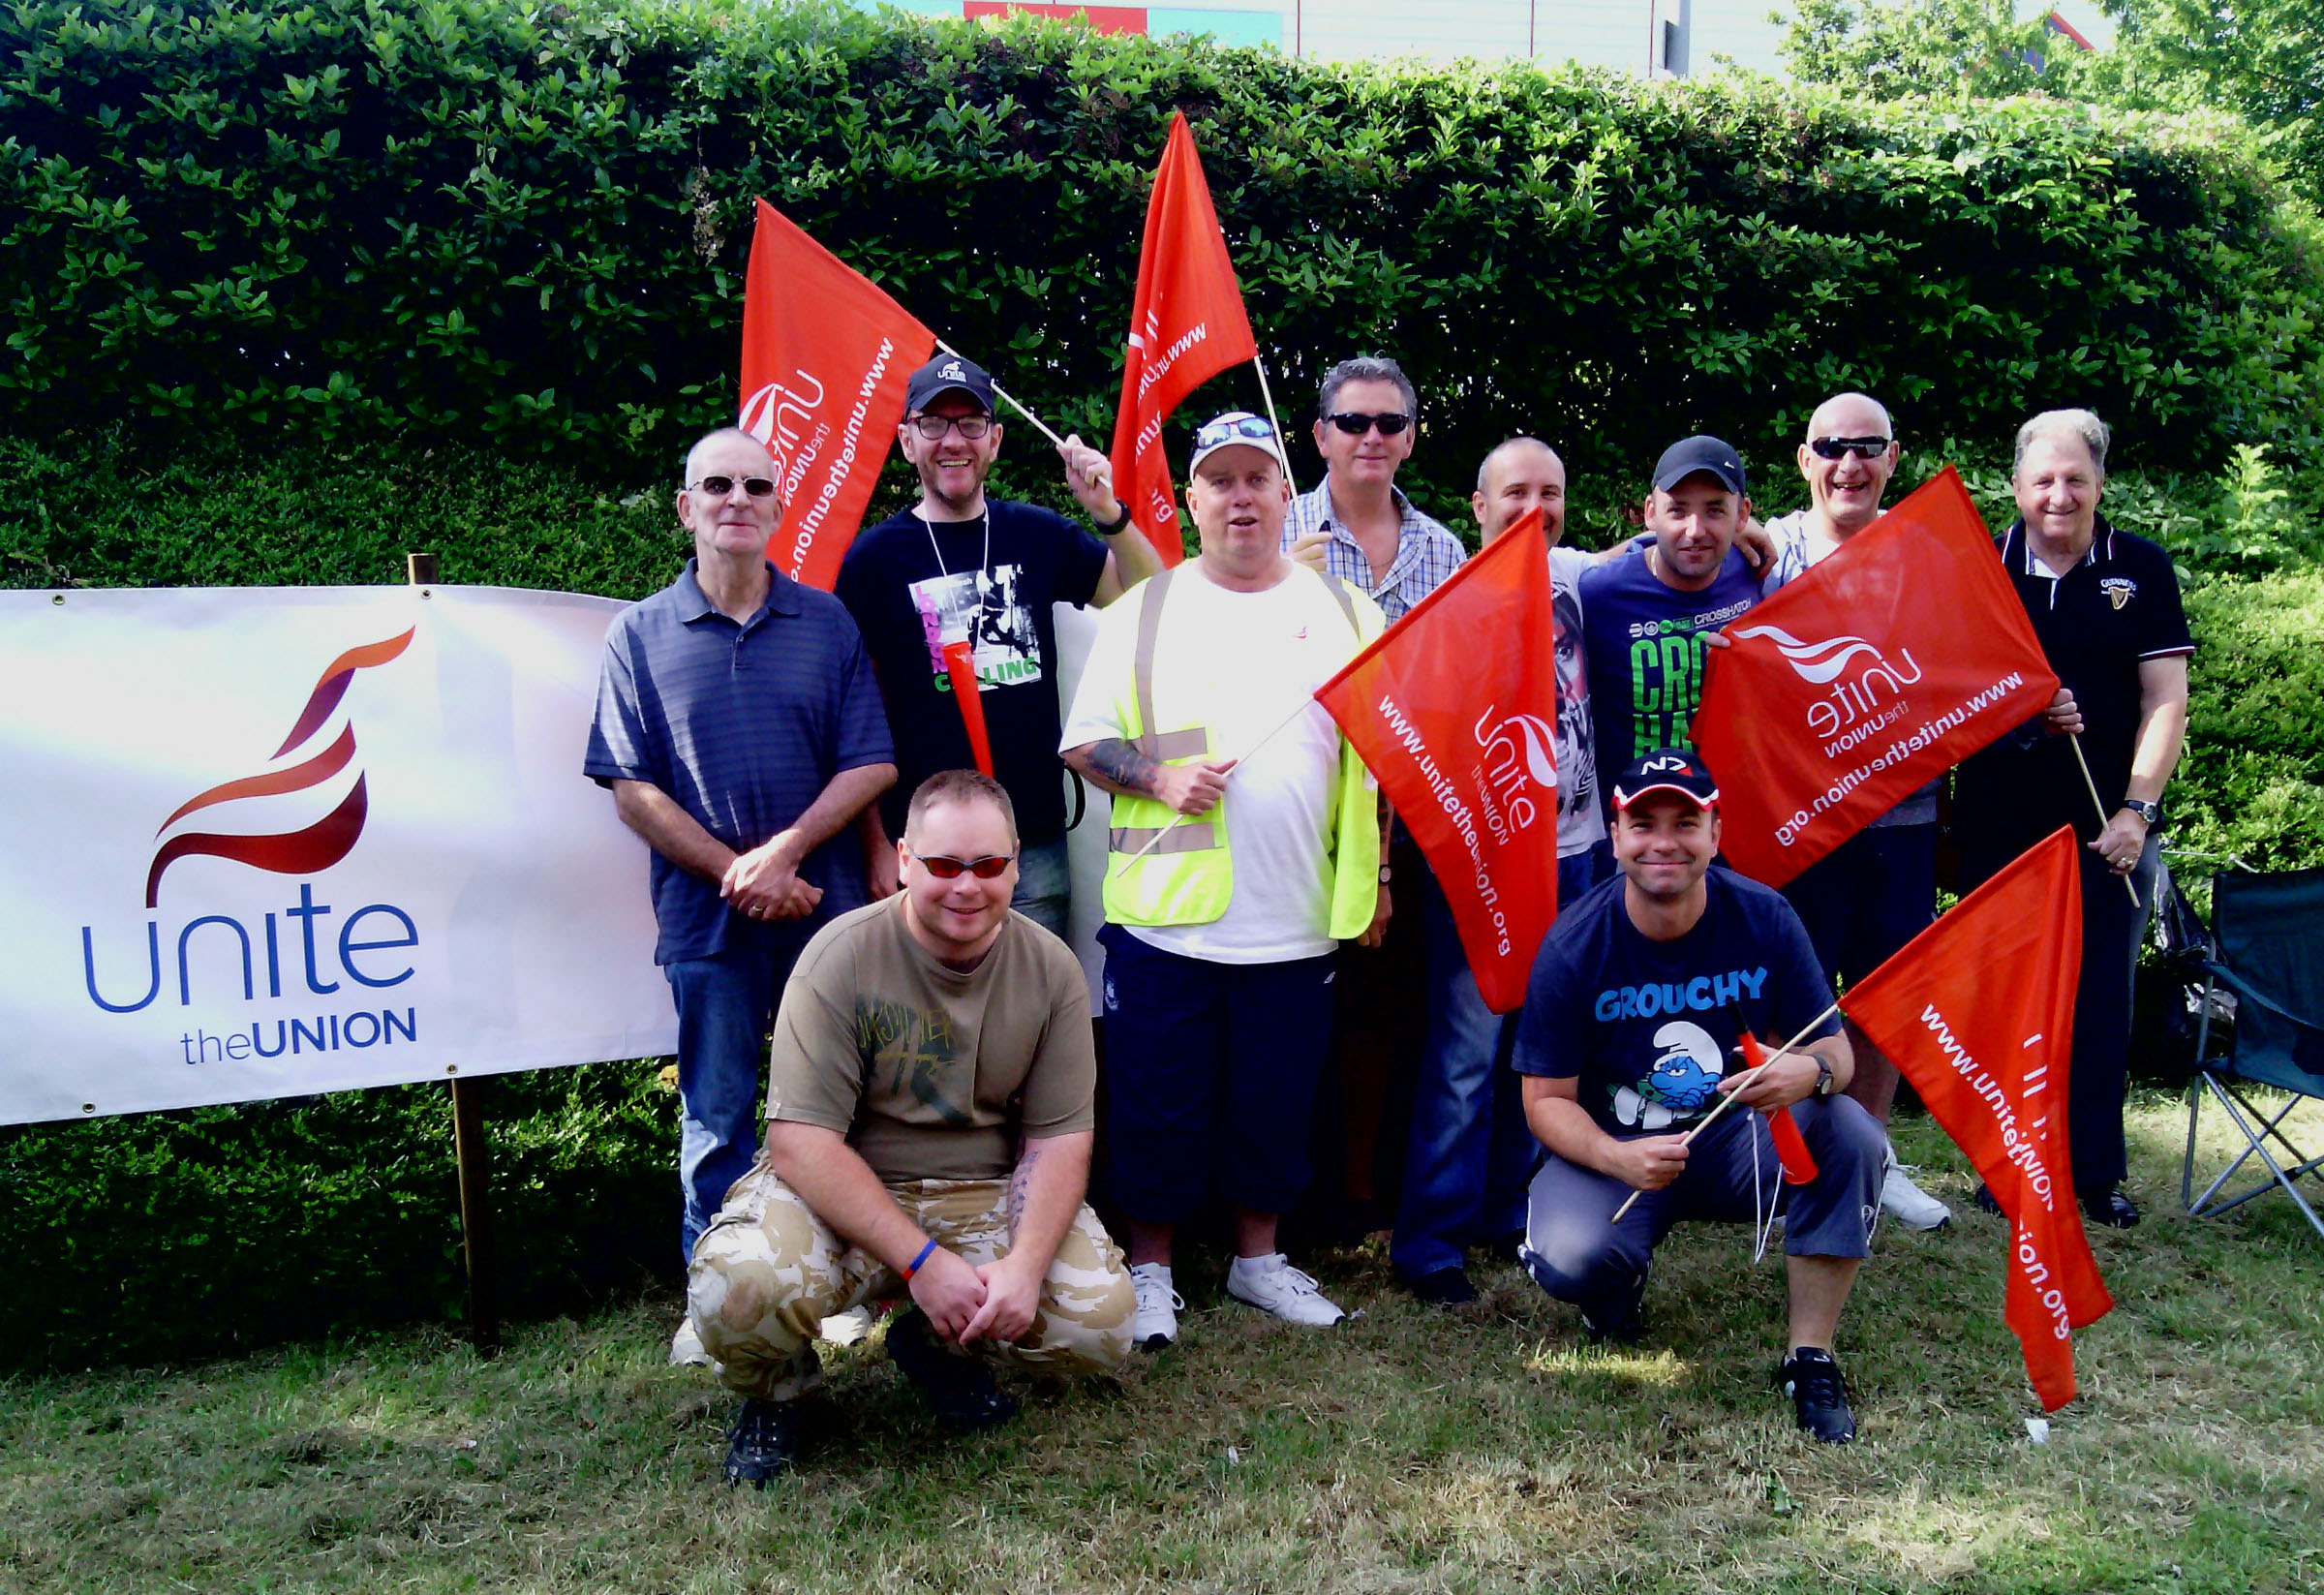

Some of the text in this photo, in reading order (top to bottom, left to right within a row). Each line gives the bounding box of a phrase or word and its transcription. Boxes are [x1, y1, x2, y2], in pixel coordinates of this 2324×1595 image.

[1695, 598, 1751, 625] CROSSHATCH
[933, 657, 1037, 691] CLING
[1474, 704, 1537, 834] unite
[1378, 694, 1511, 957] www.unitetheunion.org
[1471, 764, 1510, 846] theUNION
[82, 883, 419, 1013] unite
[1596, 966, 1768, 1022] GROUCHY
[180, 1007, 417, 1065] theUNION
